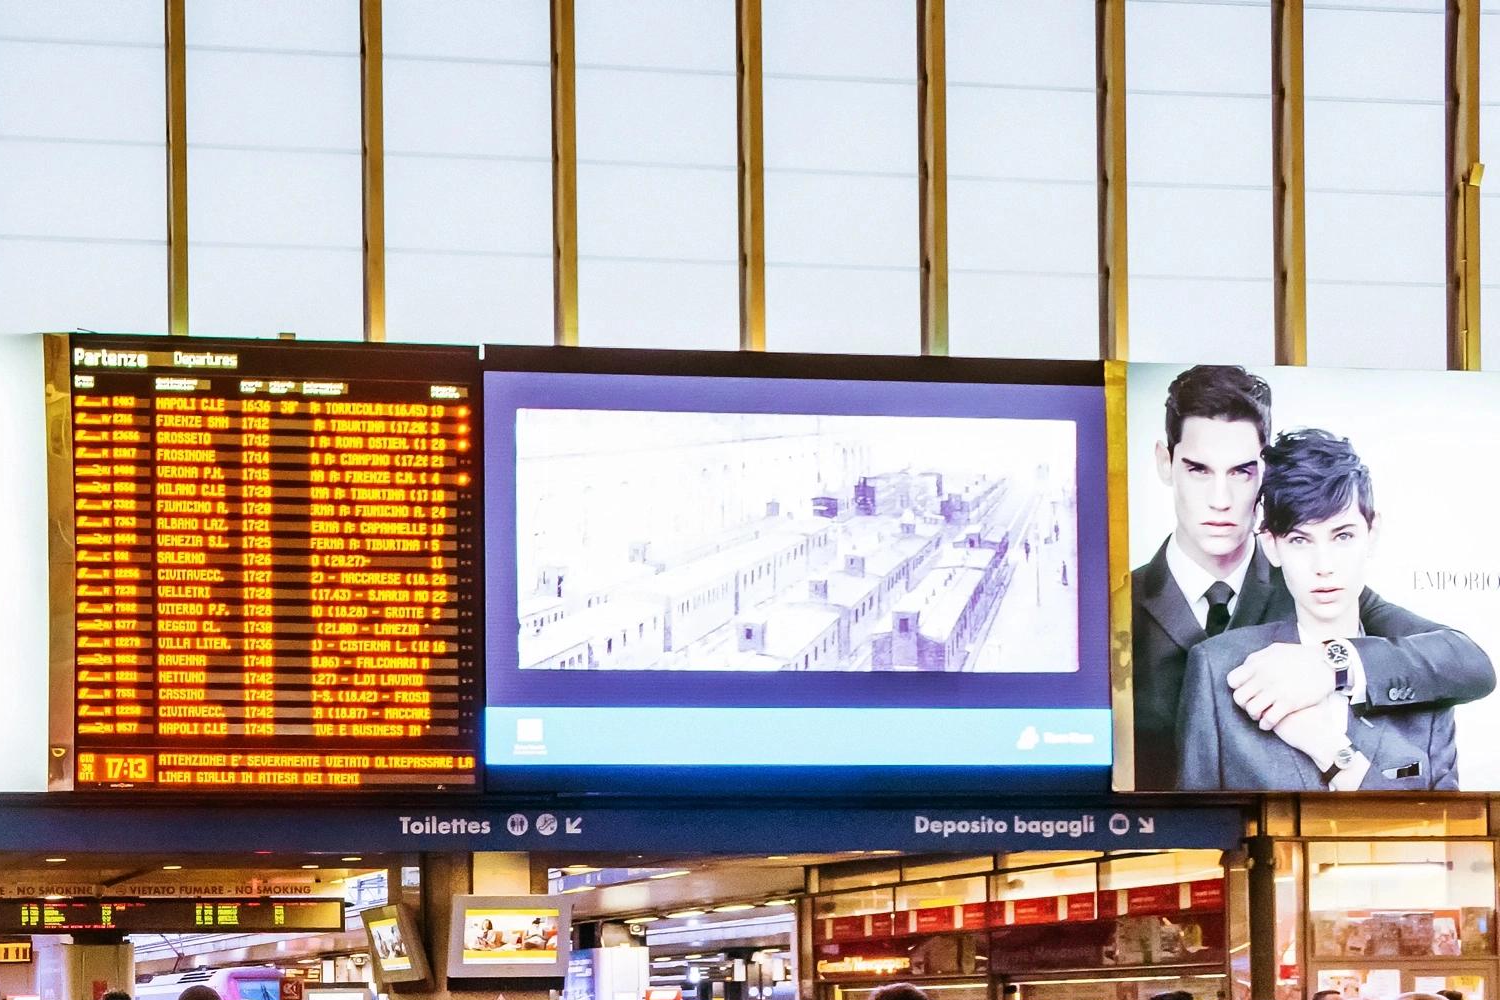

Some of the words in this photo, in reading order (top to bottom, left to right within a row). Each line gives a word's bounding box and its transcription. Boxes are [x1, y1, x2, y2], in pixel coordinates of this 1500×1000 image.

[74, 347, 148, 368] Partenze
[173, 351, 238, 368] Departures
[156, 397, 197, 410] NAPOLI
[156, 414, 203, 428] FIRENZE
[242, 417, 271, 430] 17:12
[157, 431, 213, 445] GROSSETO
[242, 434, 271, 447] 17:12
[157, 448, 216, 462] FROSINONE
[157, 465, 200, 478] VERONA
[345, 471, 391, 484] FIRENZE
[157, 483, 197, 496] MILANO
[157, 500, 213, 513] FIUMICINO
[157, 517, 199, 530] ALBANO
[243, 519, 271, 531] 17:21
[157, 534, 204, 547] VENEZIA
[157, 551, 207, 564] SALERNO
[157, 569, 225, 581] CIVITAVECC.
[243, 570, 273, 582] 17:27
[1413, 571, 1500, 591] EMPORIO
[158, 585, 211, 598] VELLETRI
[158, 603, 204, 615] VITERBO
[158, 620, 198, 632] REGGIO
[158, 637, 192, 649] VILLA
[158, 654, 207, 666] RAVENNA
[159, 671, 207, 683] NETTUNO
[244, 672, 274, 685] 17:42
[159, 688, 206, 700] CASSINO
[244, 689, 274, 701] 17:42
[159, 706, 227, 718] CIVITAVECC.
[244, 706, 275, 718] 17:42
[159, 723, 199, 735] NAPOLI
[245, 723, 275, 735] 17:45
[104, 757, 147, 779] 17:13
[246, 755, 320, 767] SEVERAMENTE
[324, 756, 370, 768] VIETATO
[374, 756, 453, 768] OLTREPASSARE
[457, 756, 473, 768] LA
[157, 771, 191, 783] LINEA
[195, 771, 236, 783] GIALLA
[240, 772, 253, 783] IN
[257, 772, 298, 784] ATTESA
[302, 773, 323, 784] DEI
[327, 773, 359, 784] TRENI
[399, 816, 491, 835] Toilettes
[915, 815, 1008, 837] Deposito
[1014, 815, 1095, 838] bagagli
[16, 886, 35, 896] NO
[129, 886, 175, 896] VIETATO
[179, 886, 225, 895] FUMARE
[235, 885, 253, 895] NO
[256, 885, 312, 895] SMOKING
